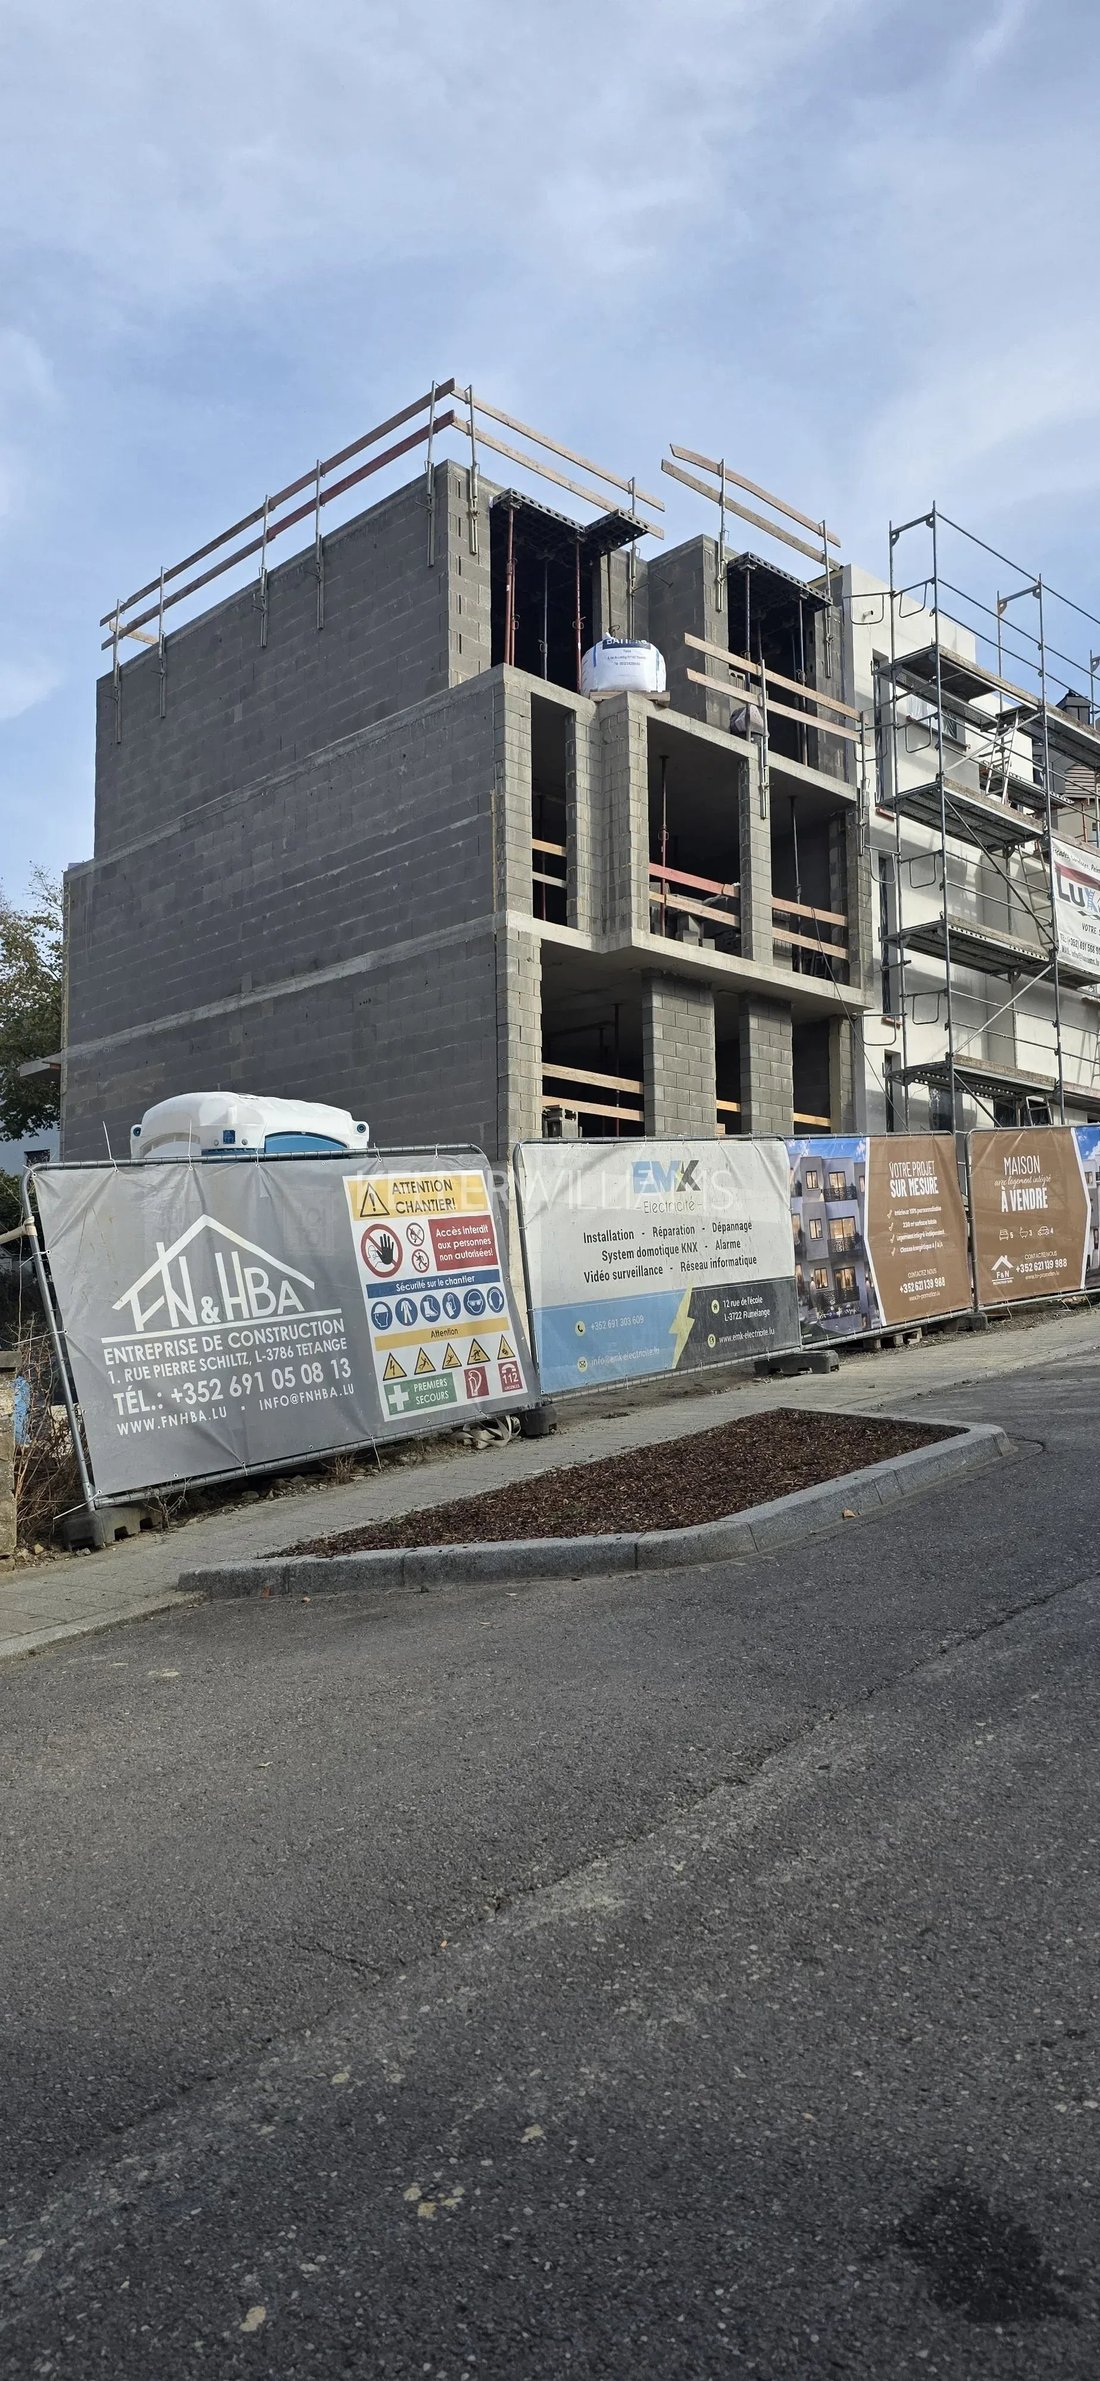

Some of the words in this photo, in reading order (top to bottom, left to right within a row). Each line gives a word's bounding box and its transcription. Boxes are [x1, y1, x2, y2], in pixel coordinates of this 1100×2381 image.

[1082, 922, 1097, 935] VOTRE
[889, 1161, 911, 1178] VOTRE
[912, 1160, 935, 1177] PROJET
[1003, 1155, 1040, 1175] MAISON
[631, 1159, 701, 1193] EMK
[1007, 1175, 1032, 1189] logement
[392, 1179, 453, 1195] ATTENTION
[889, 1178, 907, 1198] SUR
[908, 1176, 939, 1196] MESURE
[395, 1198, 456, 1214] CHANTIER!
[1001, 1185, 1008, 1213] À
[1009, 1187, 1048, 1212] VENDRE
[436, 1227, 462, 1237] Accès
[462, 1225, 488, 1235] interdit
[583, 1229, 634, 1244] Installation
[652, 1224, 695, 1240] Réparation
[712, 1221, 752, 1235] Dépannage
[437, 1242, 451, 1250] aux
[453, 1238, 491, 1251] personnes
[601, 1250, 634, 1264] System
[636, 1244, 679, 1259] domotique
[681, 1241, 698, 1254] KNX
[715, 1239, 741, 1251] Alarme
[439, 1253, 453, 1262] non
[455, 1247, 493, 1260] autorisées!
[584, 1269, 610, 1283] Vidéo
[612, 1264, 663, 1281] surveillance
[680, 1258, 708, 1272] Réseau
[709, 1254, 757, 1270] informatique
[1016, 1262, 1033, 1273] +352
[1034, 1261, 1044, 1270] 621
[1055, 1258, 1067, 1268] 988
[396, 1280, 426, 1293] Sécurité
[427, 1279, 437, 1288] sur
[437, 1278, 444, 1286] le
[445, 1275, 475, 1286] chantier
[900, 1282, 914, 1293] +352
[722, 1299, 730, 1308] 12
[741, 1297, 747, 1306] de
[591, 1318, 606, 1331] +352
[607, 1318, 620, 1329] 691
[620, 1316, 632, 1327] 303
[632, 1314, 645, 1326] 609
[724, 1311, 742, 1322] L-3722
[743, 1308, 770, 1319] Rumelange
[104, 1338, 198, 1365] ENTREPRISE
[202, 1335, 223, 1352] DE
[228, 1318, 345, 1348] CONSTRUCTION
[430, 1328, 459, 1339] Attention
[124, 1367, 151, 1382] RUE
[154, 1359, 197, 1378] PIERRE
[200, 1352, 252, 1372] SCHILTZ,
[255, 1345, 294, 1363] L-3786
[298, 1337, 347, 1357] TETANGE
[171, 1378, 224, 1405] +352
[229, 1371, 264, 1396] 691
[271, 1367, 296, 1390] 05
[301, 1362, 324, 1384] 08
[331, 1358, 352, 1379] 13
[413, 1378, 448, 1393] PREMIERS
[502, 1372, 519, 1384] 112
[415, 1391, 449, 1405] SECOURS
[117, 1406, 227, 1435] WWW.FNHBA.LU
[259, 1384, 355, 1411] INFO@FNHBA.LU
